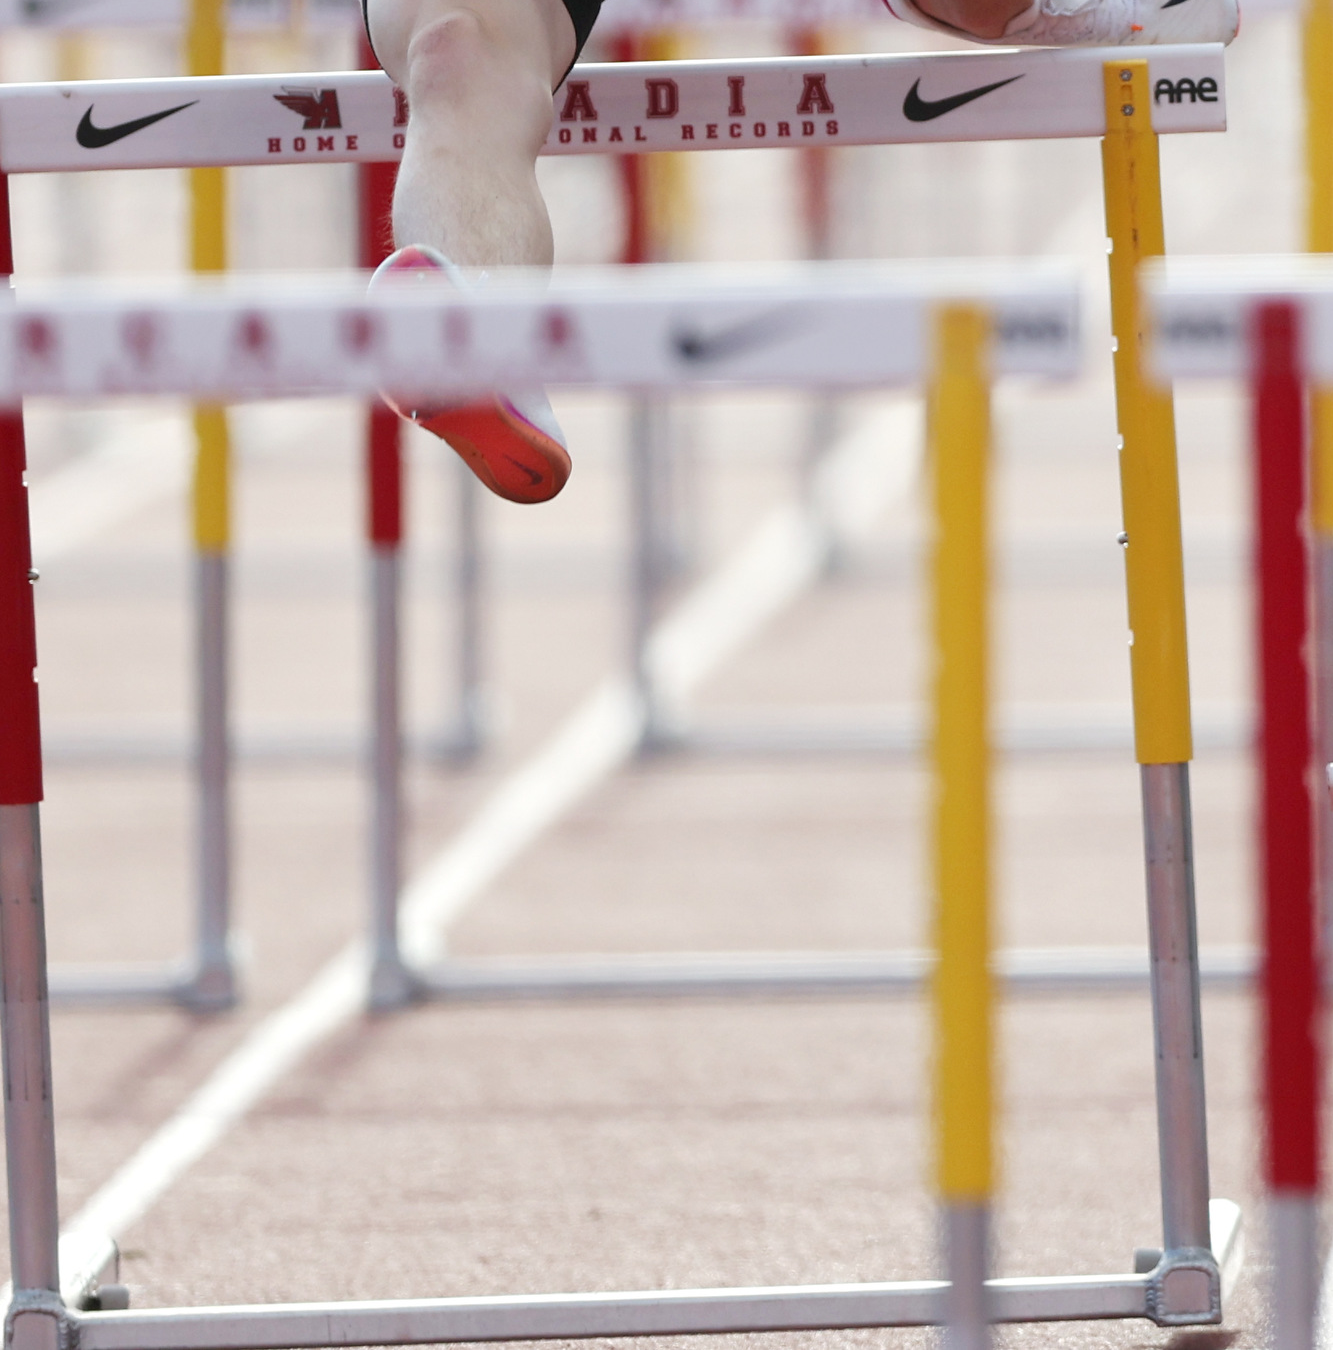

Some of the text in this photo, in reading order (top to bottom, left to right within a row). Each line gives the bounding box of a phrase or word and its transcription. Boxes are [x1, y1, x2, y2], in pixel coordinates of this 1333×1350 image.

[273, 73, 835, 130] AADIA
[268, 135, 359, 154] HOME
[681, 120, 840, 141] RECORDS
